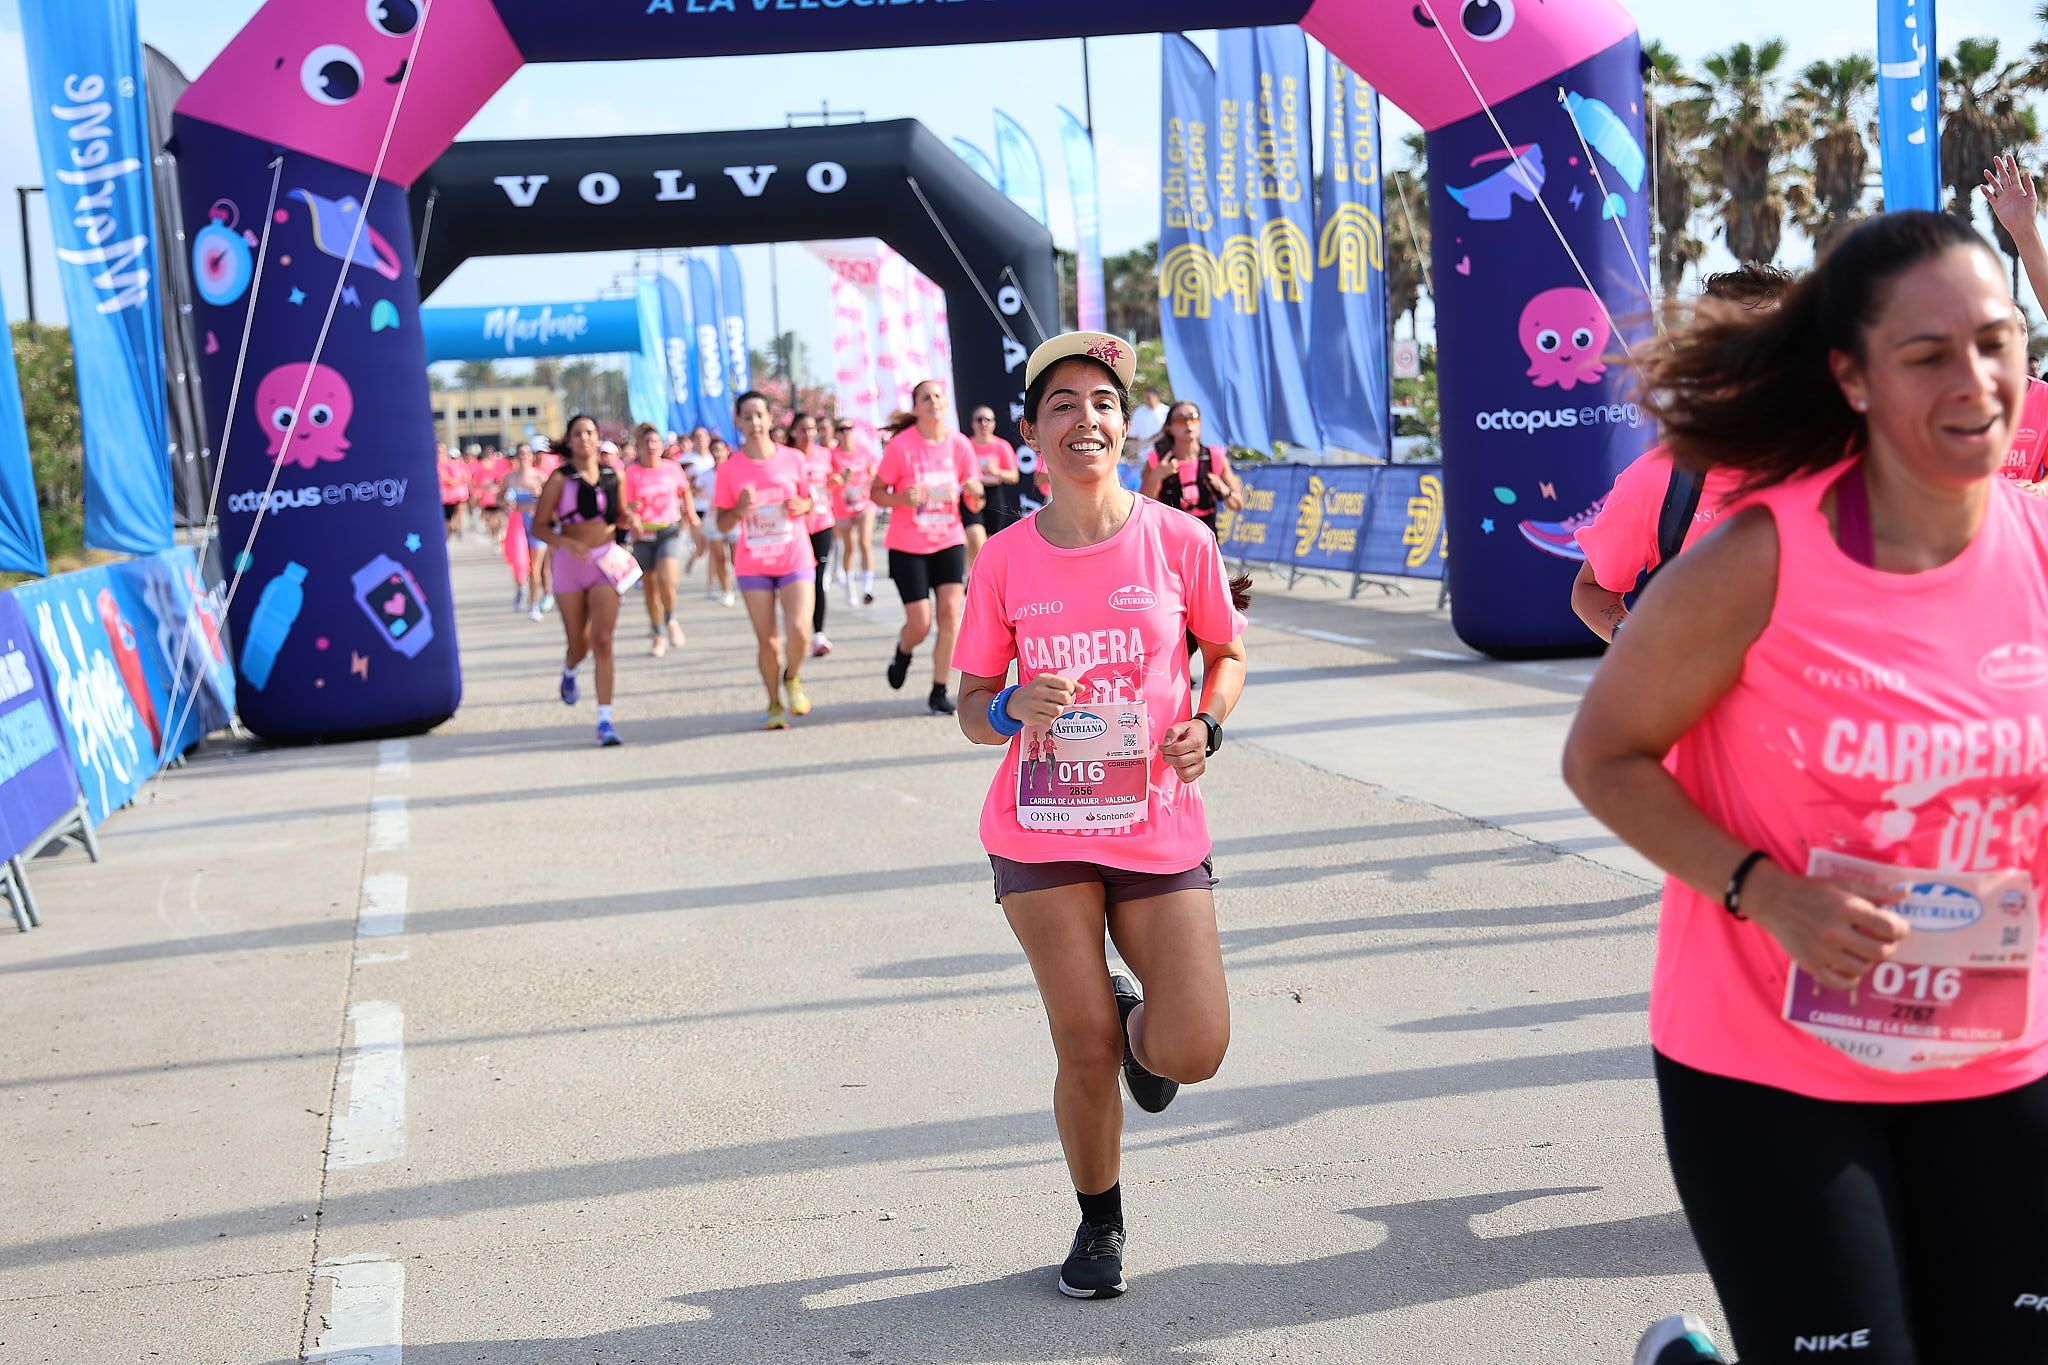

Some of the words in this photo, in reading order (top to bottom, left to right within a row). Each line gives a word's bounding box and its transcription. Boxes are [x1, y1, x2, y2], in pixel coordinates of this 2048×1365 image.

[494, 161, 847, 207] VOLVO
[1476, 407, 1578, 435] octopus
[228, 486, 322, 516] octopus
[322, 477, 409, 507] energy
[1015, 600, 1063, 620] OYSHO
[1113, 596, 1154, 605] ASTURIANA
[1024, 627, 1145, 670] CARRERA
[1055, 723, 1103, 734] ASTURIANA
[1822, 714, 2048, 782] CARRERA
[1058, 761, 1106, 783] 016
[1029, 797, 1057, 805] CARRERA
[1067, 798, 1076, 806] LA
[1077, 797, 1100, 806] MUJER
[1105, 795, 1137, 805] VALENCIA
[1070, 786, 1093, 796] 2856
[1030, 811, 1070, 822] OYSHO
[1096, 811, 1136, 821] Santander
[1872, 961, 1963, 1001] 016
[1891, 1003, 1936, 1021] 2767
[1865, 1018, 1882, 1033] DE
[1883, 1020, 1900, 1034] LA
[1793, 1328, 1871, 1353] NIKE
